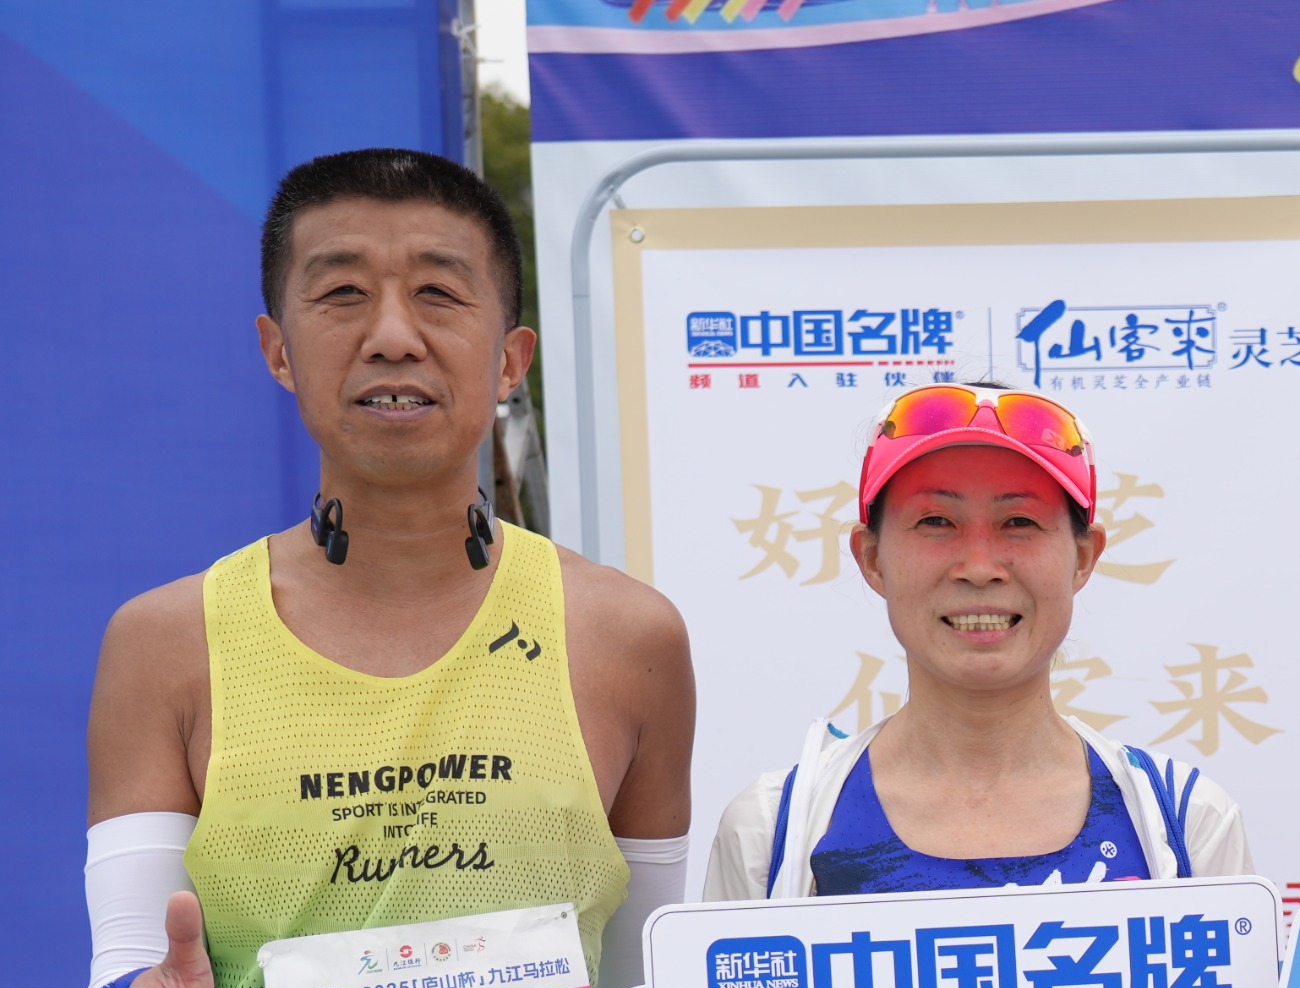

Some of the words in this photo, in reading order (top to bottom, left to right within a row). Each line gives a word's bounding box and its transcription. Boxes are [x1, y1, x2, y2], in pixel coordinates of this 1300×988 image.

[740, 309, 953, 356] 中国名牌
[690, 372, 954, 389] 频道入驻伙伴
[1050, 373, 1213, 391] 有机灵芝全产业链
[300, 754, 513, 800] NENGPOWER
[332, 803, 383, 821] SPORT
[388, 803, 398, 816] IS
[401, 790, 487, 816] INTGRATED
[715, 950, 799, 980] 新华社
[766, 978, 799, 988] NEWS
